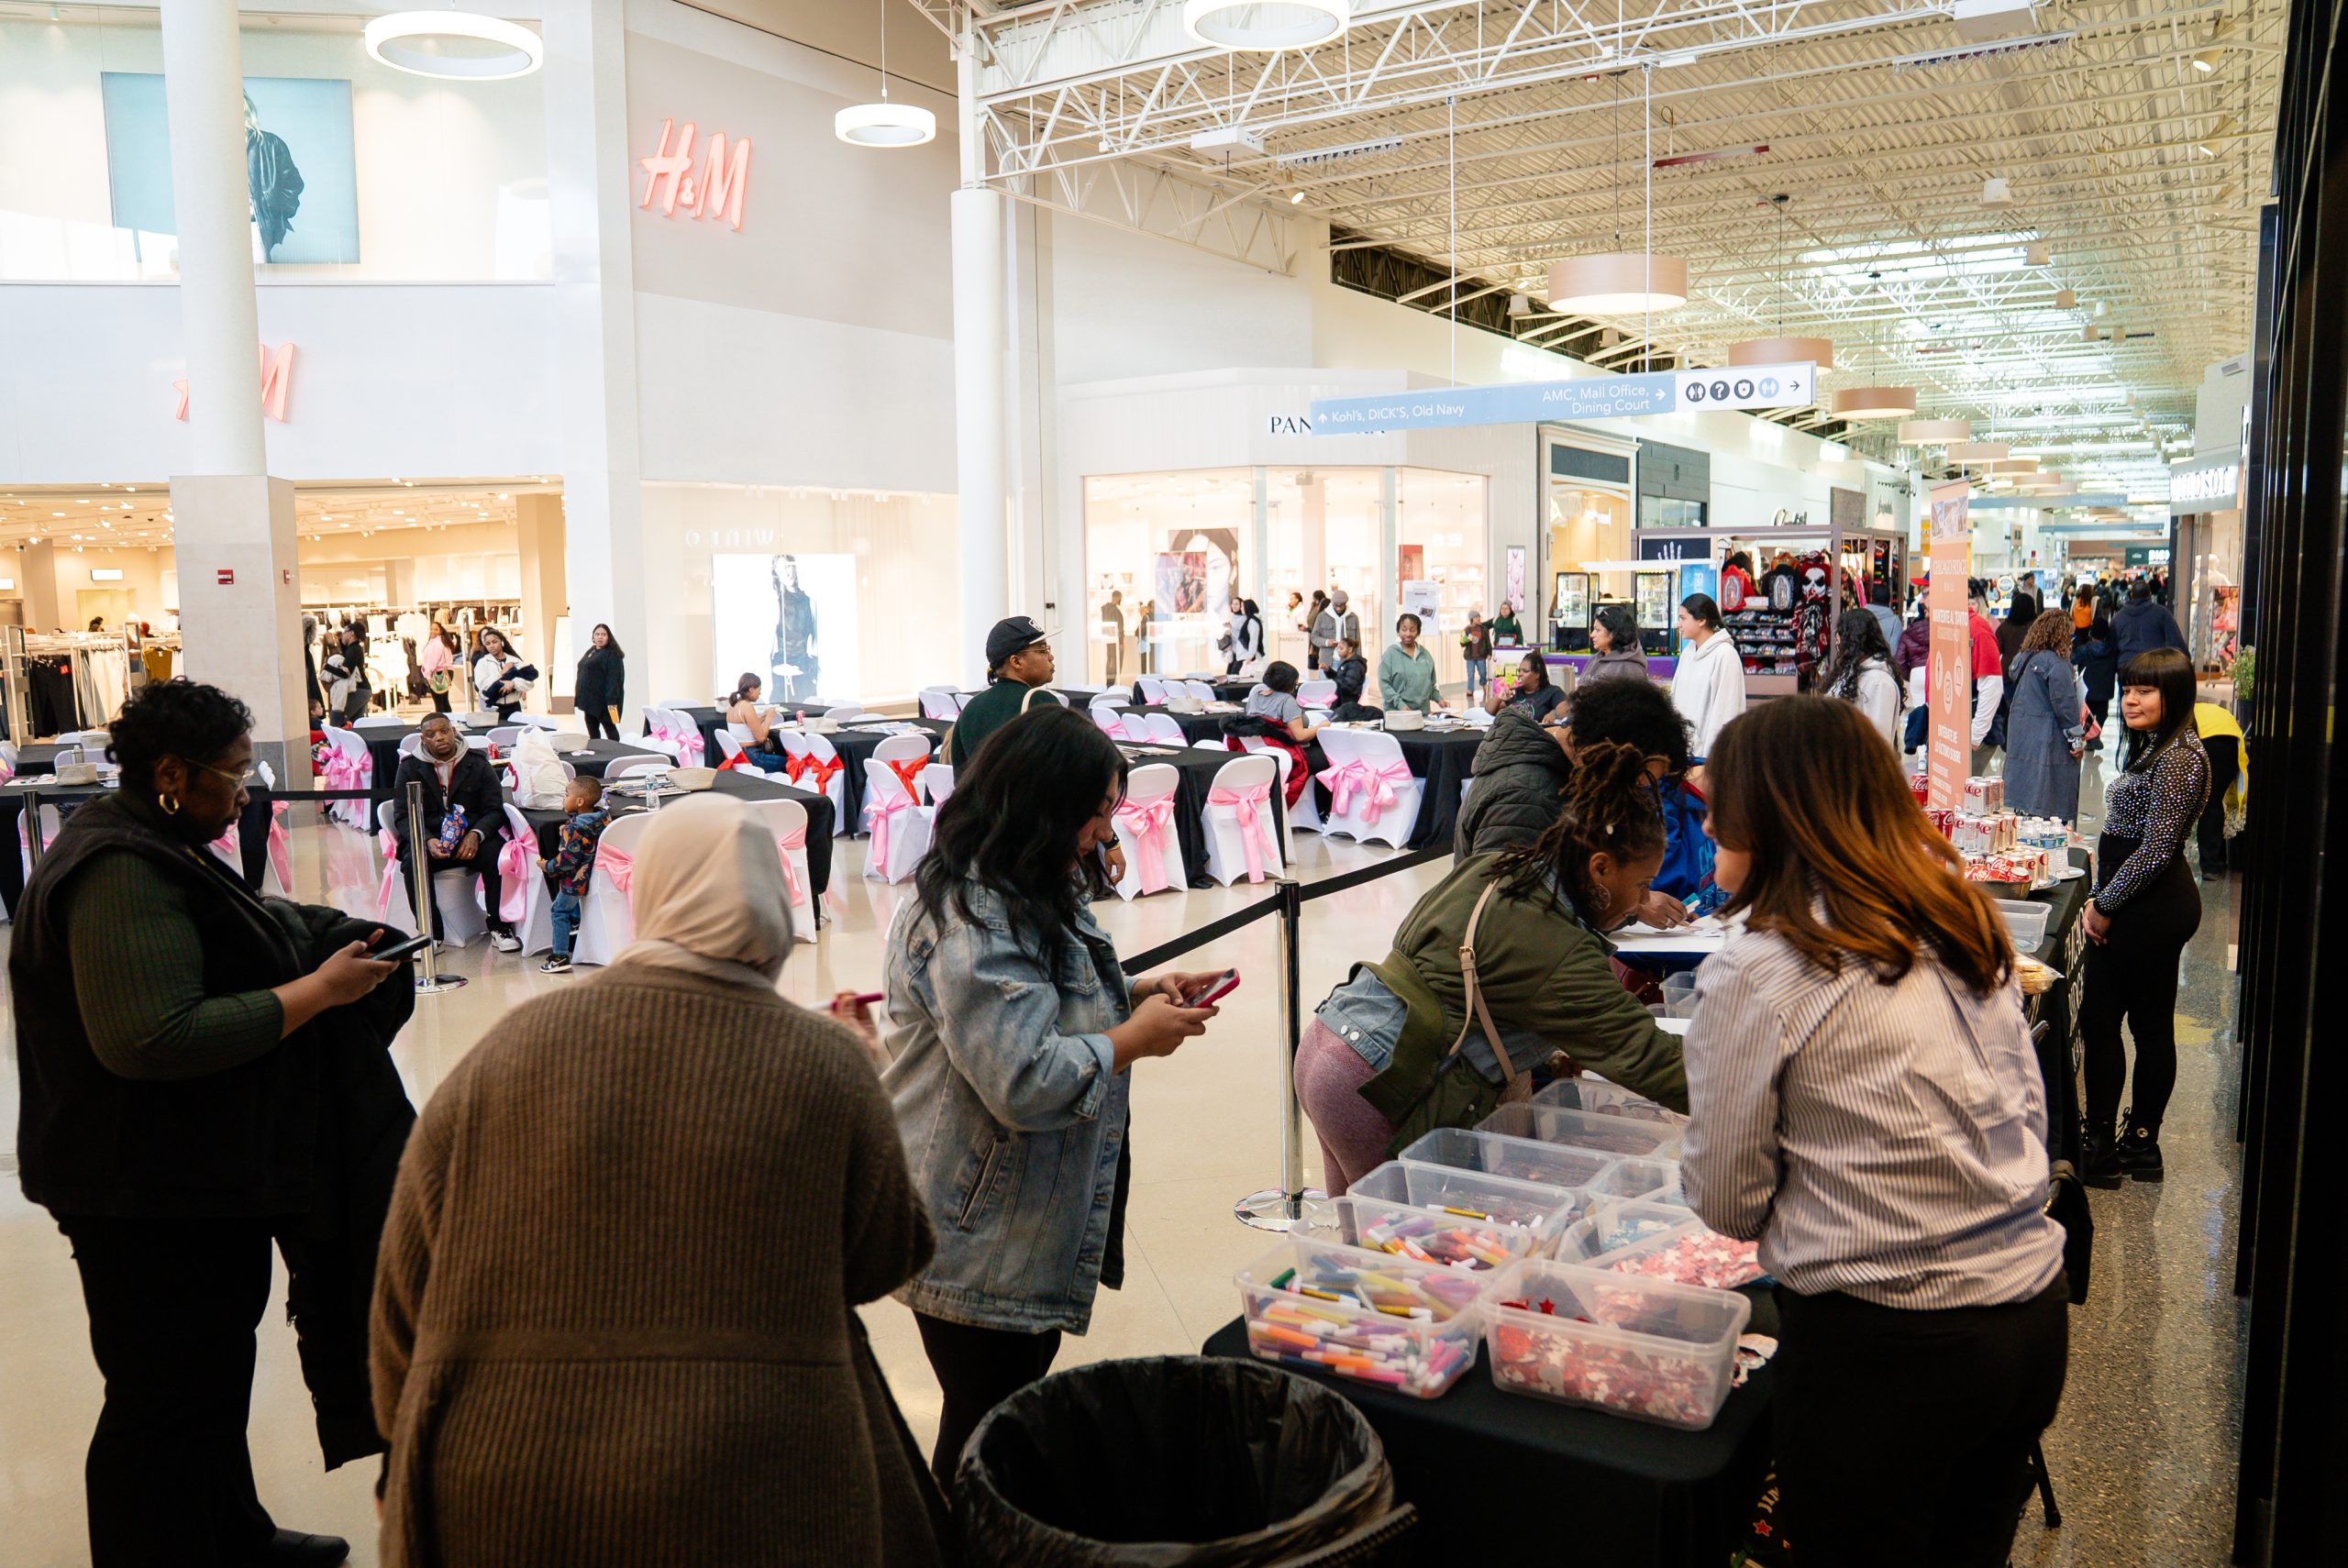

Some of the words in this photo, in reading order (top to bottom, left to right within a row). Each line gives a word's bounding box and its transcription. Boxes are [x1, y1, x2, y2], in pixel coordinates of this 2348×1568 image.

[641, 117, 753, 231] H&M
[1542, 388, 1576, 403] AMC,
[1580, 383, 1605, 399] Mall
[1609, 383, 1650, 398] Office,
[1332, 411, 1366, 423] Kohl's,
[1368, 407, 1410, 421] DICK'S,
[1412, 404, 1434, 417] Old
[1436, 403, 1466, 417] Navy
[1572, 402, 1611, 415] Dining
[1614, 399, 1650, 412] Court
